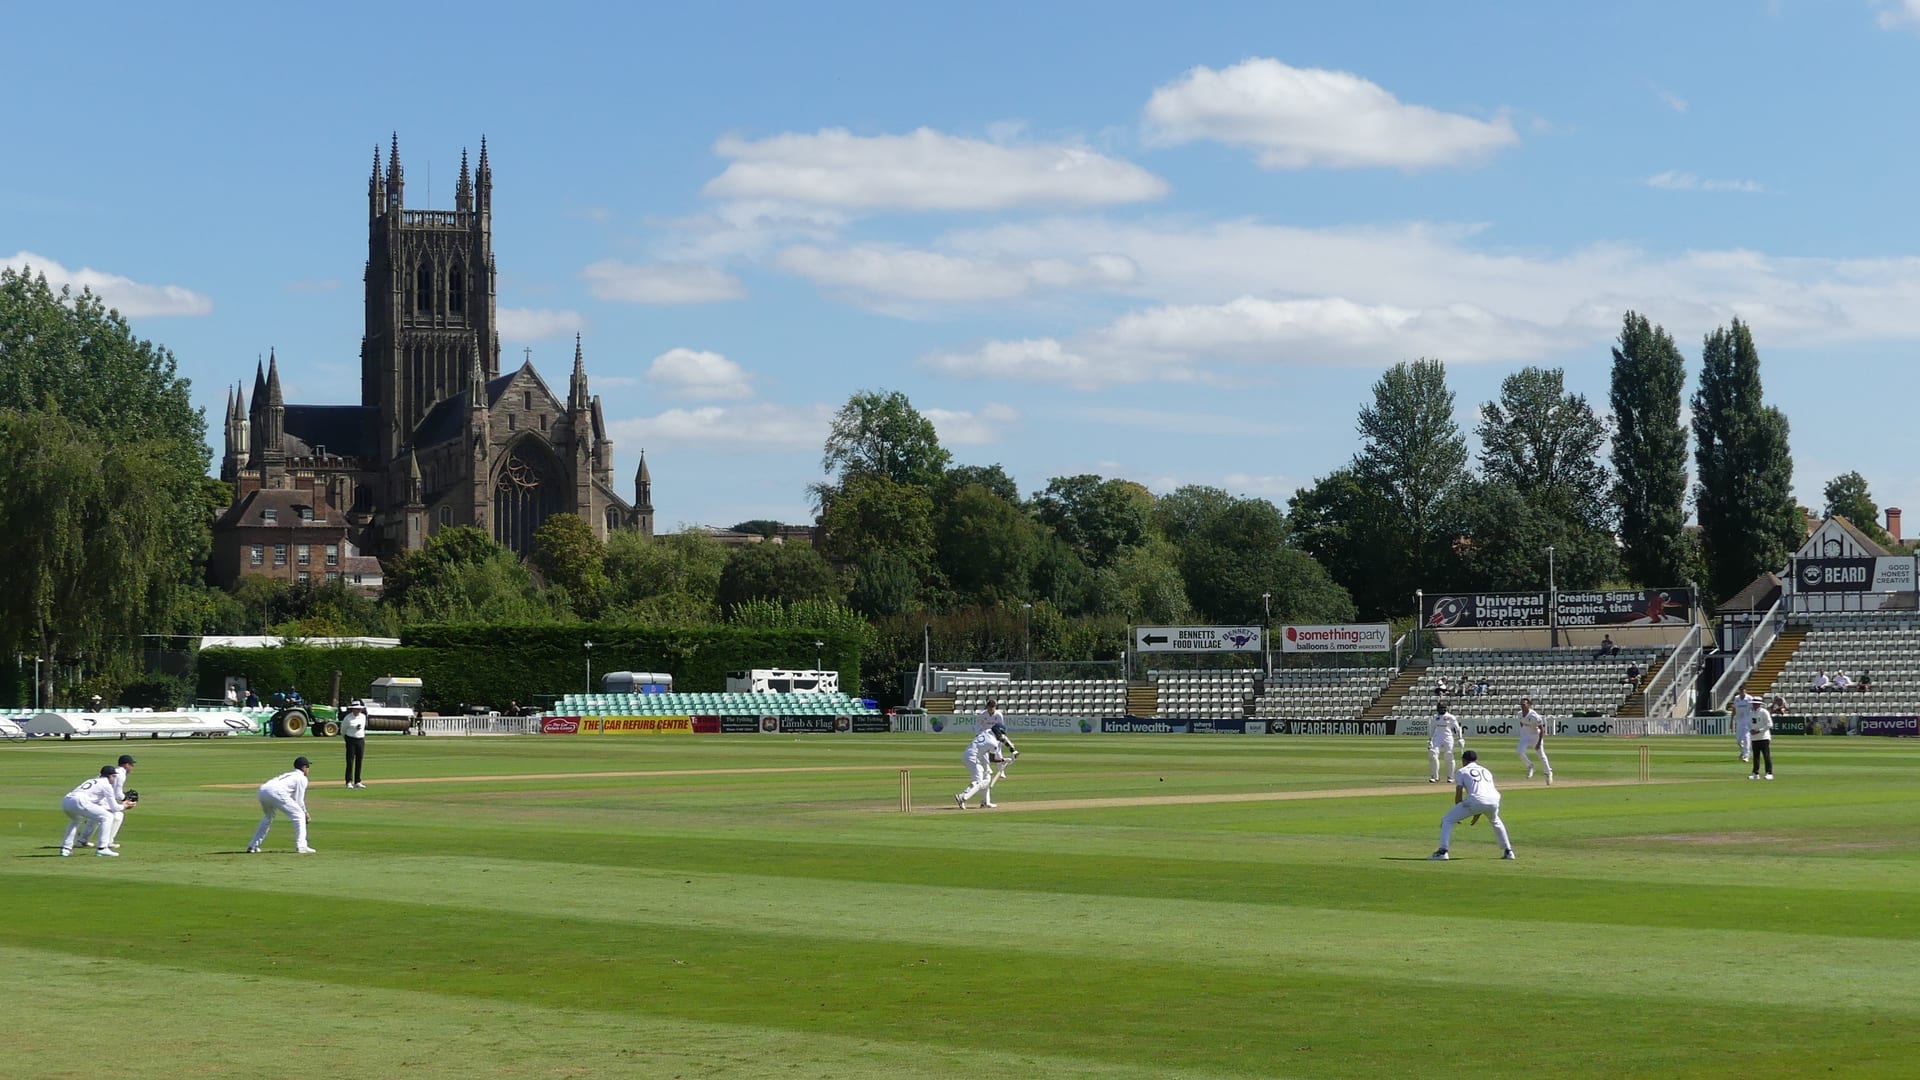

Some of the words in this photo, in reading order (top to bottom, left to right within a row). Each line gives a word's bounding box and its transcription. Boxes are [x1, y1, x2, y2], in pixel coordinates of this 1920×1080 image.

[1825, 567, 1866, 583] BEARD
[1475, 594, 1544, 607] Universal
[1558, 592, 1603, 604] Creating
[1605, 591, 1635, 603] Signs
[1638, 592, 1645, 601] &
[1475, 606, 1530, 620] Display
[1530, 607, 1544, 615] Ltd
[1558, 604, 1607, 615] Graphics,
[1609, 603, 1633, 613] that
[1476, 619, 1544, 627] WORCESTER
[1558, 615, 1596, 625] WORK!
[1179, 630, 1215, 640] BENNETTS
[1222, 628, 1260, 641] BENNETTS
[1173, 640, 1192, 648] FOOD
[1193, 640, 1222, 648] VILLAGE
[1296, 642, 1329, 650] balloons
[583, 720, 600, 730] THE
[603, 719, 621, 730] CAR
[622, 719, 655, 730] REFURB
[657, 719, 689, 730] CENTRE
[781, 718, 805, 728] Lamb
[806, 719, 813, 728] &
[815, 718, 833, 729] Flag
[1105, 721, 1130, 732] kind
[1132, 721, 1171, 733] wealth
[1290, 722, 1387, 736] WEAREBEARD.COM
[1781, 722, 1804, 730] KING
[1860, 719, 1917, 732] parweld
